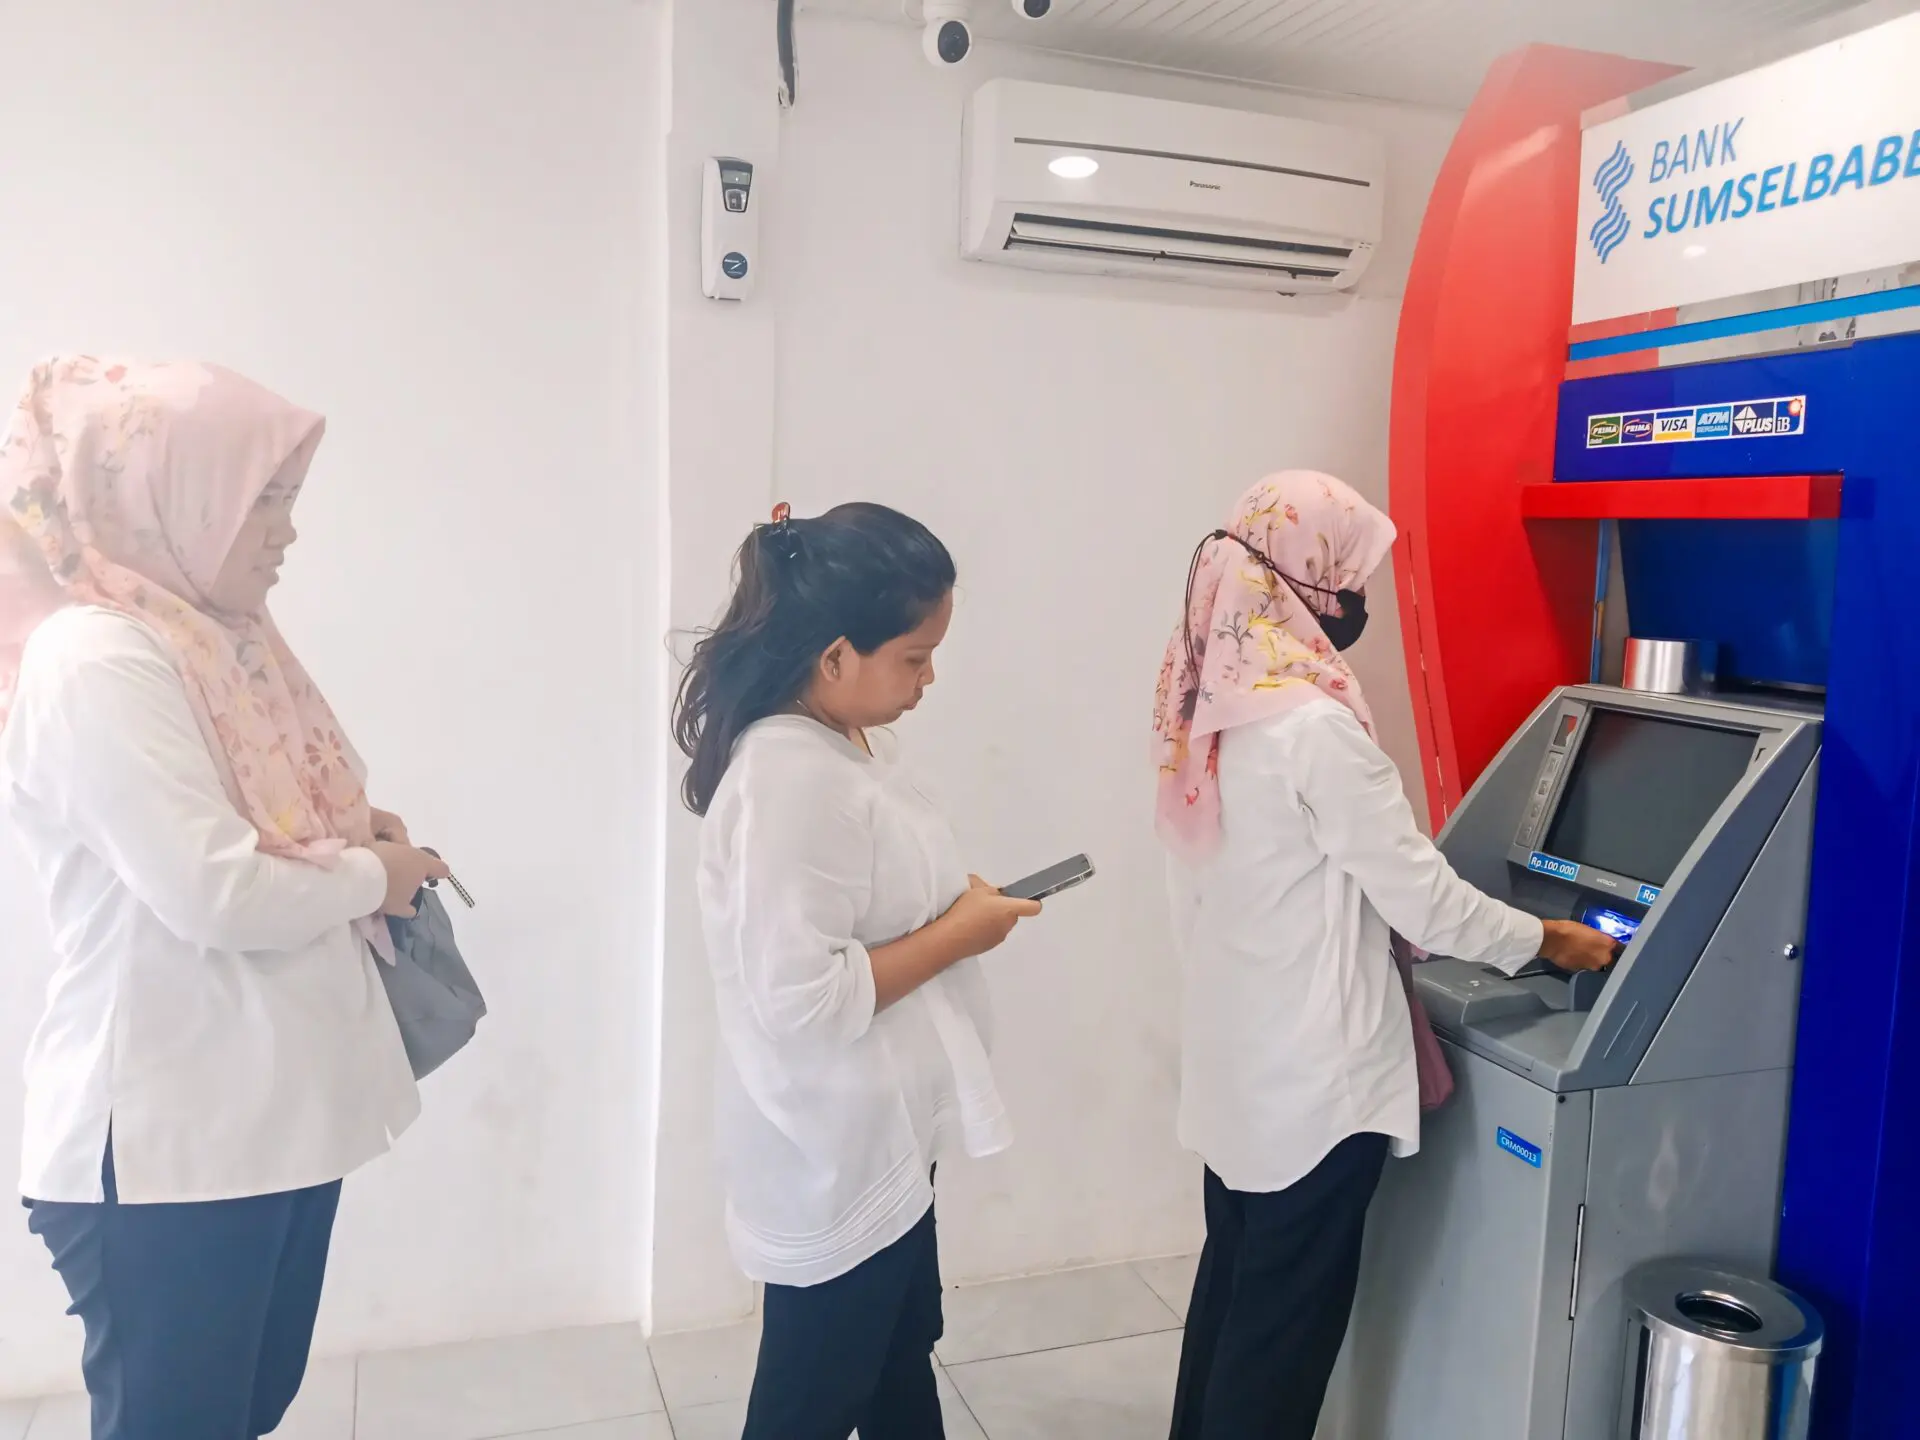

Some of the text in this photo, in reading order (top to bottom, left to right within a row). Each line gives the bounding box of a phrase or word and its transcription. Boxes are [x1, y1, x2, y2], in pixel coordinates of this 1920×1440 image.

[1649, 117, 1744, 183] BANK
[1643, 129, 1920, 239] SUMSELBABE
[1661, 418, 1688, 432] VISA
[1697, 411, 1730, 426] ATM
[1742, 417, 1774, 433] PLUS
[1592, 426, 1618, 435] PRIMA
[1625, 423, 1651, 433] PRIMA
[1530, 856, 1575, 876] Rp.100.000
